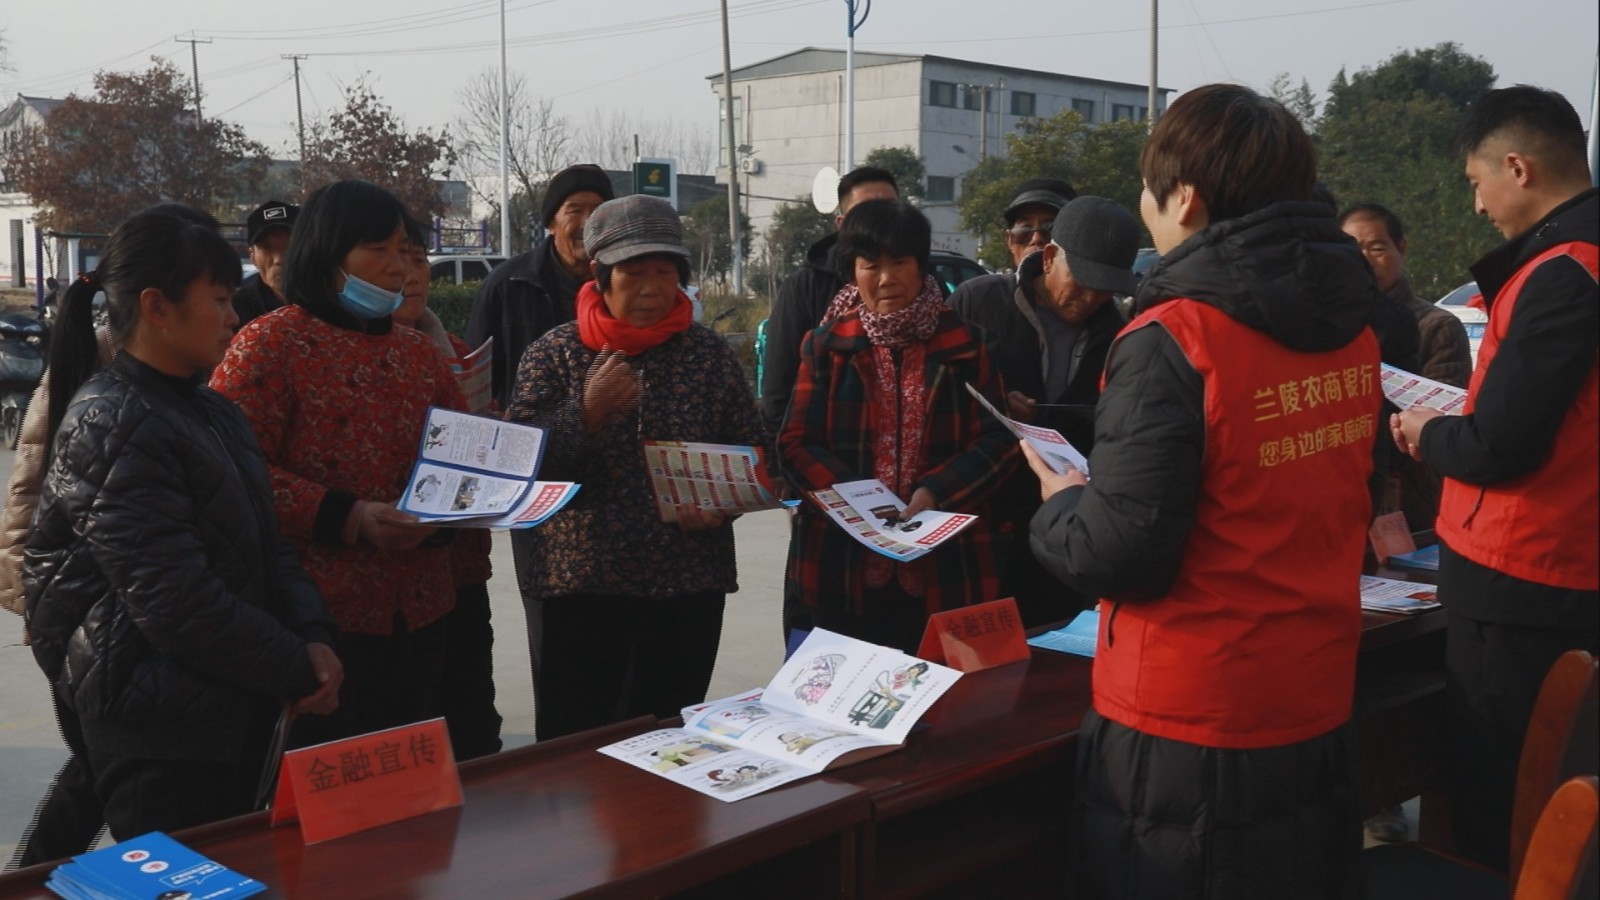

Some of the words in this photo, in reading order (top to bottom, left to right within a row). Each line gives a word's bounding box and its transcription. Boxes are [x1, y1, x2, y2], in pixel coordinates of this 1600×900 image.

[1253, 364, 1374, 422] 兰陵农商银行
[306, 732, 437, 794] 金融宣传
